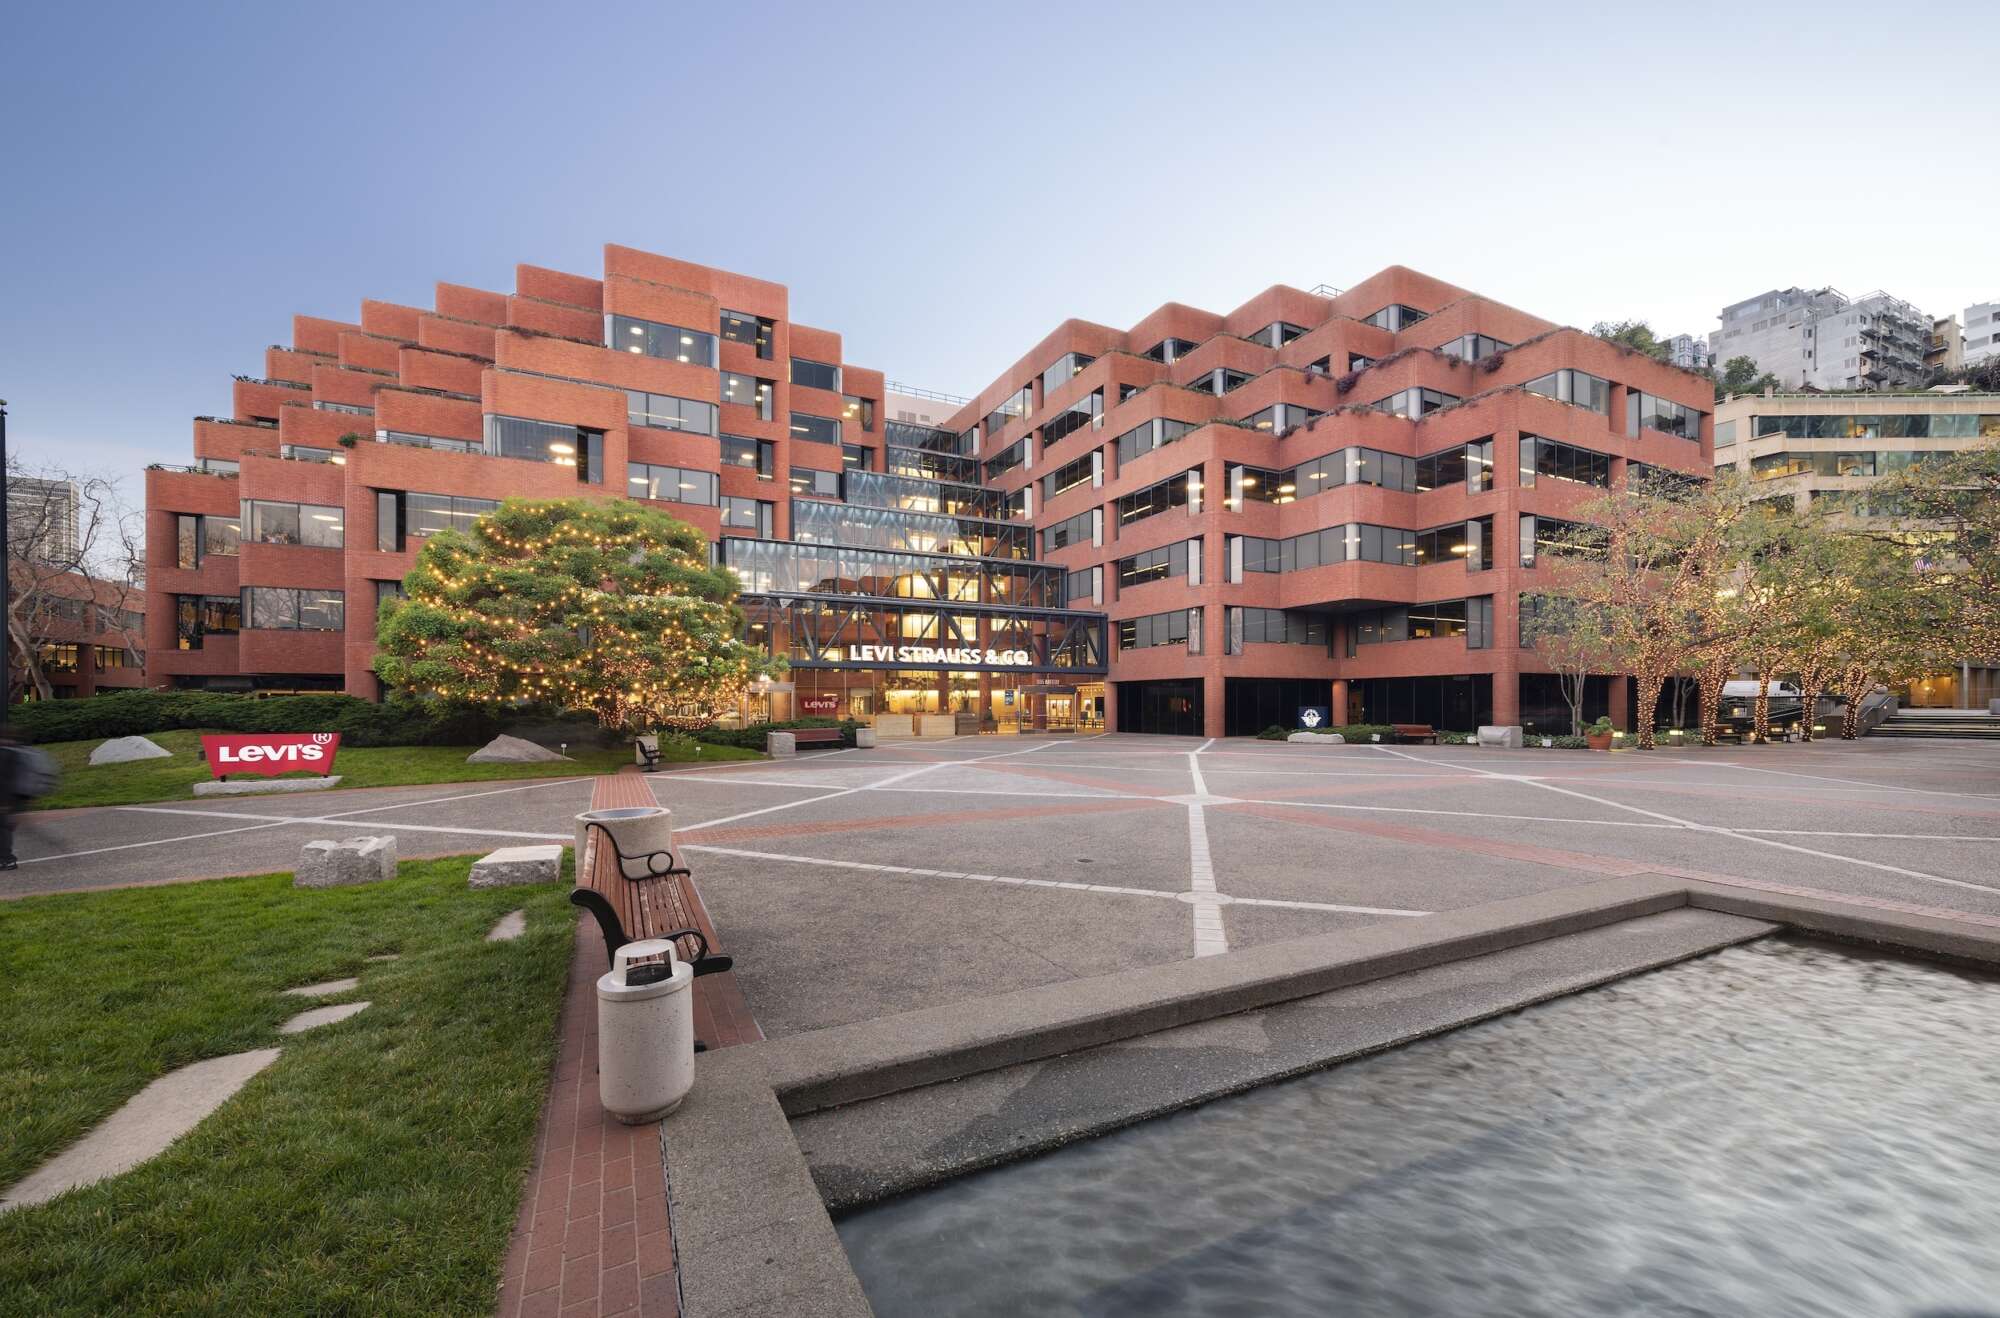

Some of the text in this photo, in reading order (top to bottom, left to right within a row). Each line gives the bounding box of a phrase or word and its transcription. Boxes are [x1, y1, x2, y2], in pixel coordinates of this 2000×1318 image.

[850, 645, 894, 662] LEVI
[899, 646, 981, 664] STRAUSS
[985, 649, 999, 666] &
